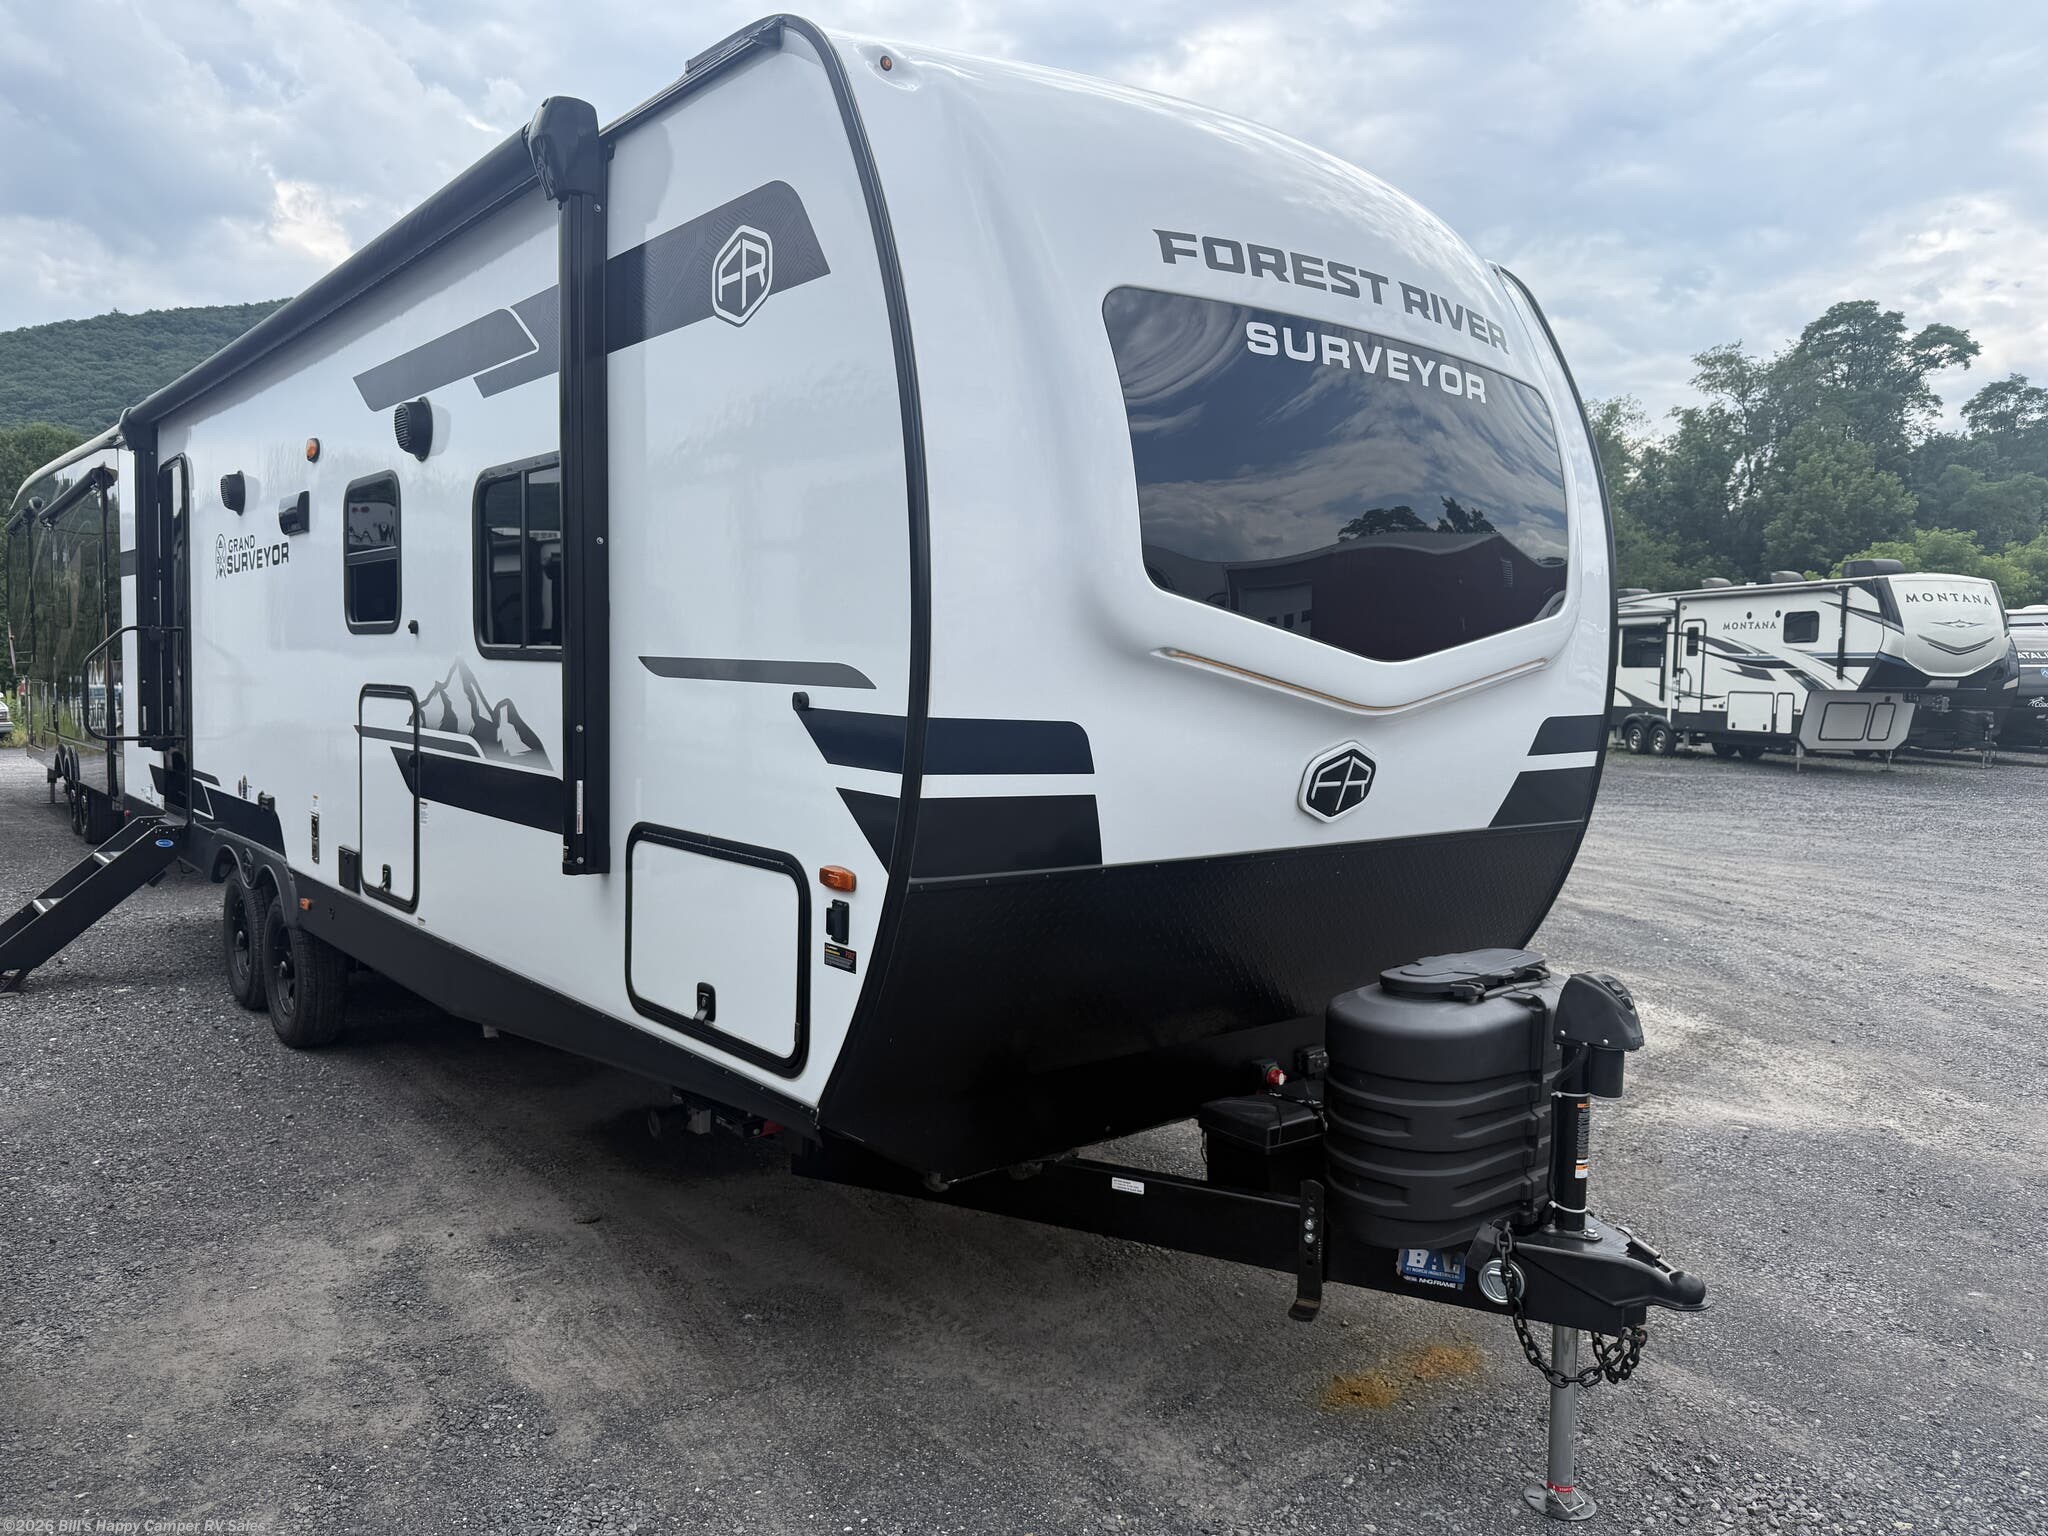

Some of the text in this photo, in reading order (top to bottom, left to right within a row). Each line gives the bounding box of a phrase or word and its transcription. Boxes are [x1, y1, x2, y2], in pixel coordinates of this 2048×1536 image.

[1152, 228, 1511, 355] FOREST RIVER
[1246, 321, 1487, 404] SURVEYOR
[228, 535, 256, 553] GRAND
[227, 542, 289, 575] SURVEYOR
[1905, 592, 1992, 606] MONTANA
[1722, 621, 1777, 630] MONTANA
